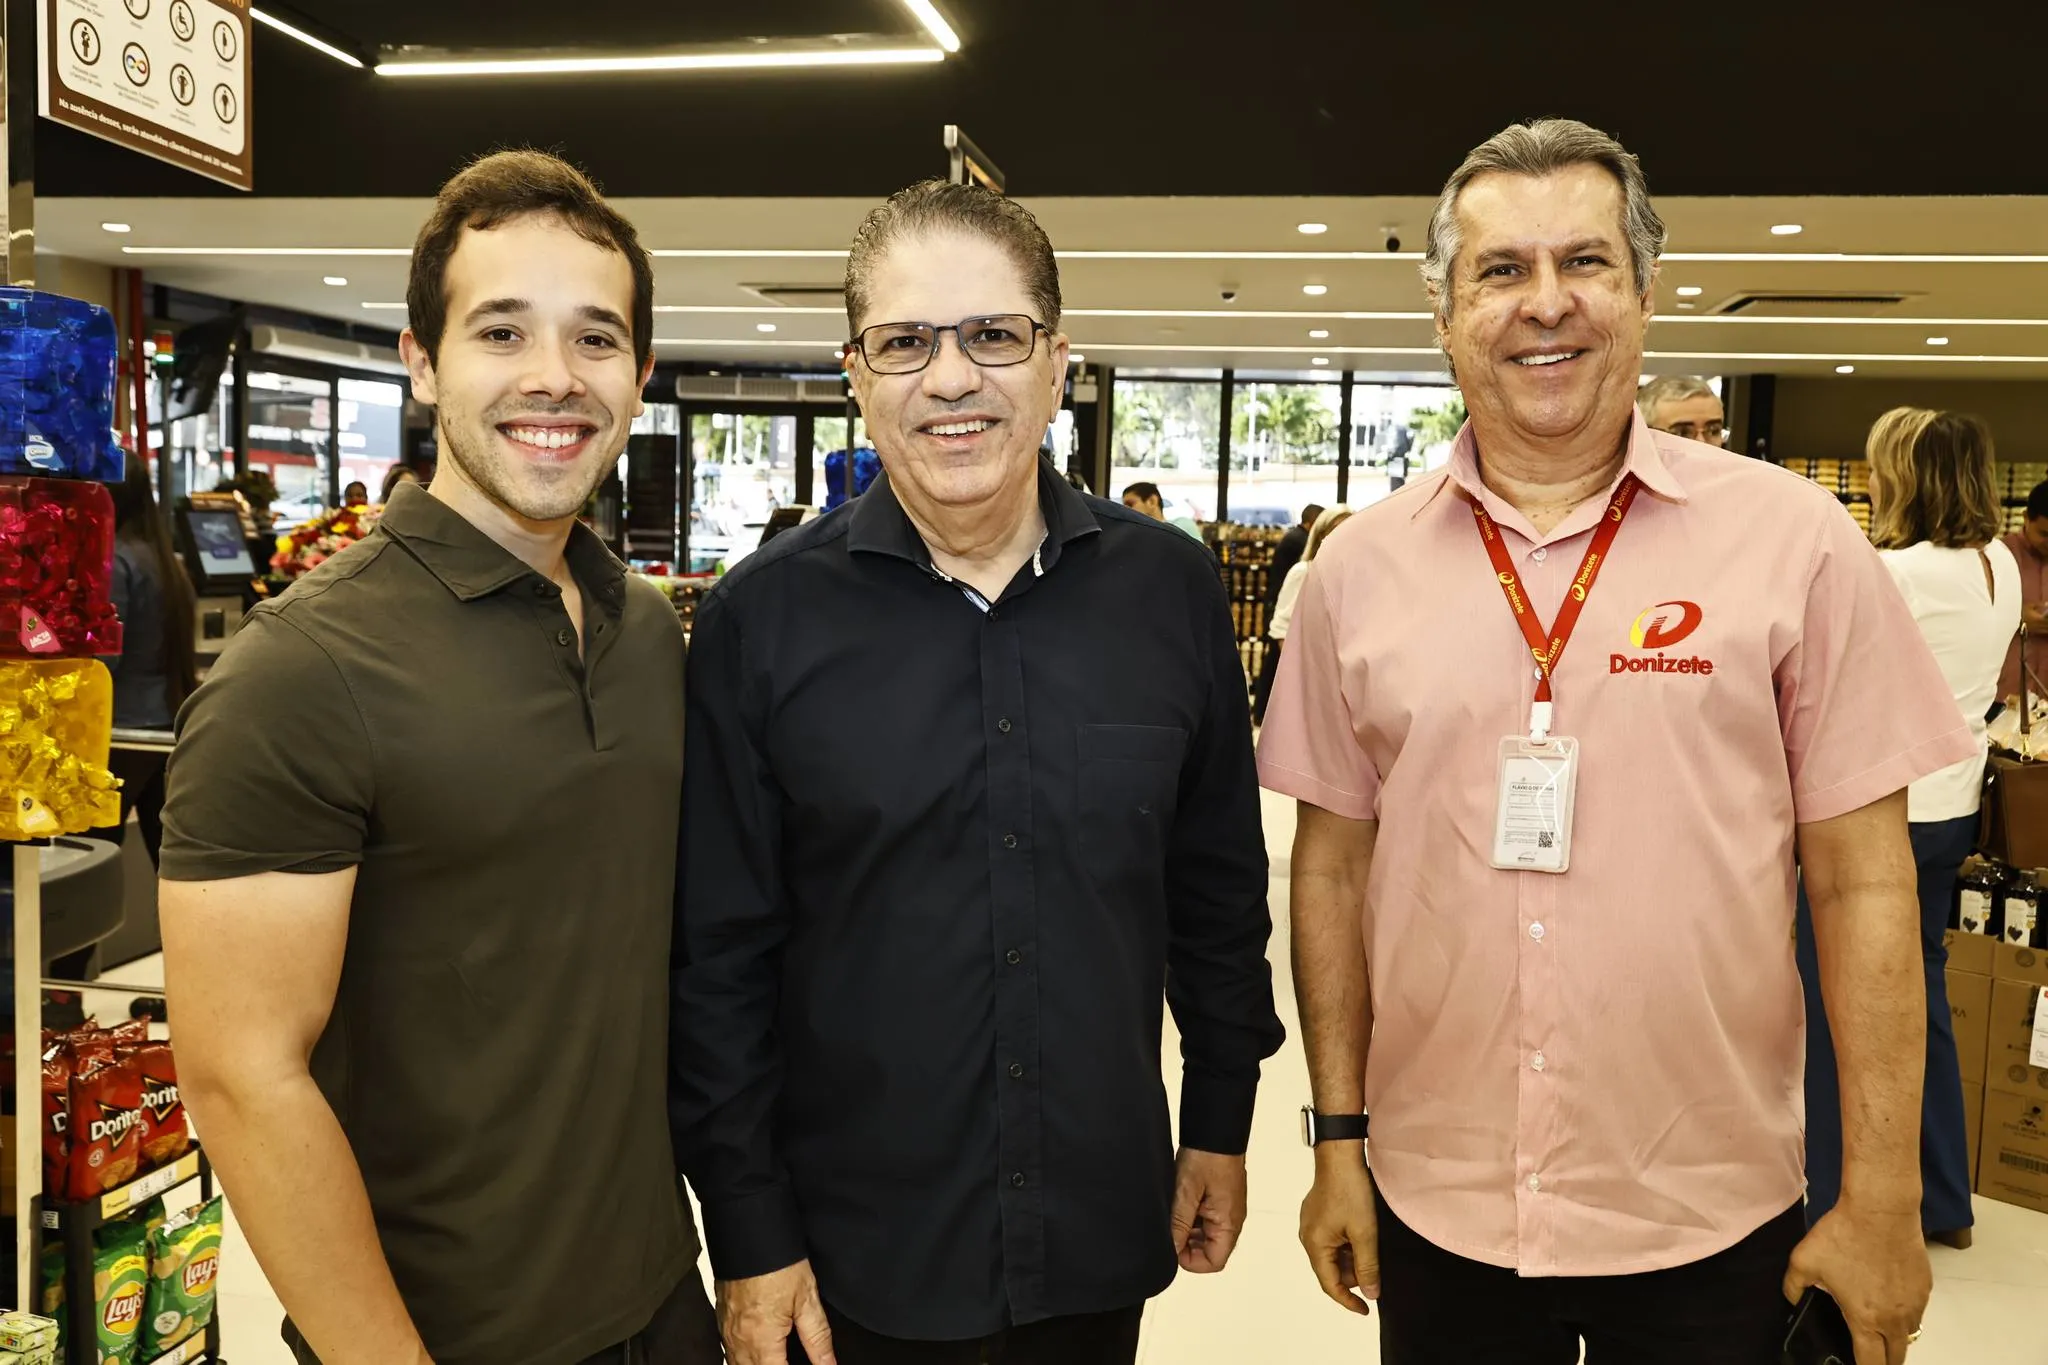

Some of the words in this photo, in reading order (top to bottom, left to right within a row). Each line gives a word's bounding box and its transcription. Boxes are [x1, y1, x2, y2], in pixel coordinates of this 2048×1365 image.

[1577, 553, 1598, 585] Donizete
[1507, 584, 1524, 615] Donizete
[1609, 652, 1714, 676] Donizete
